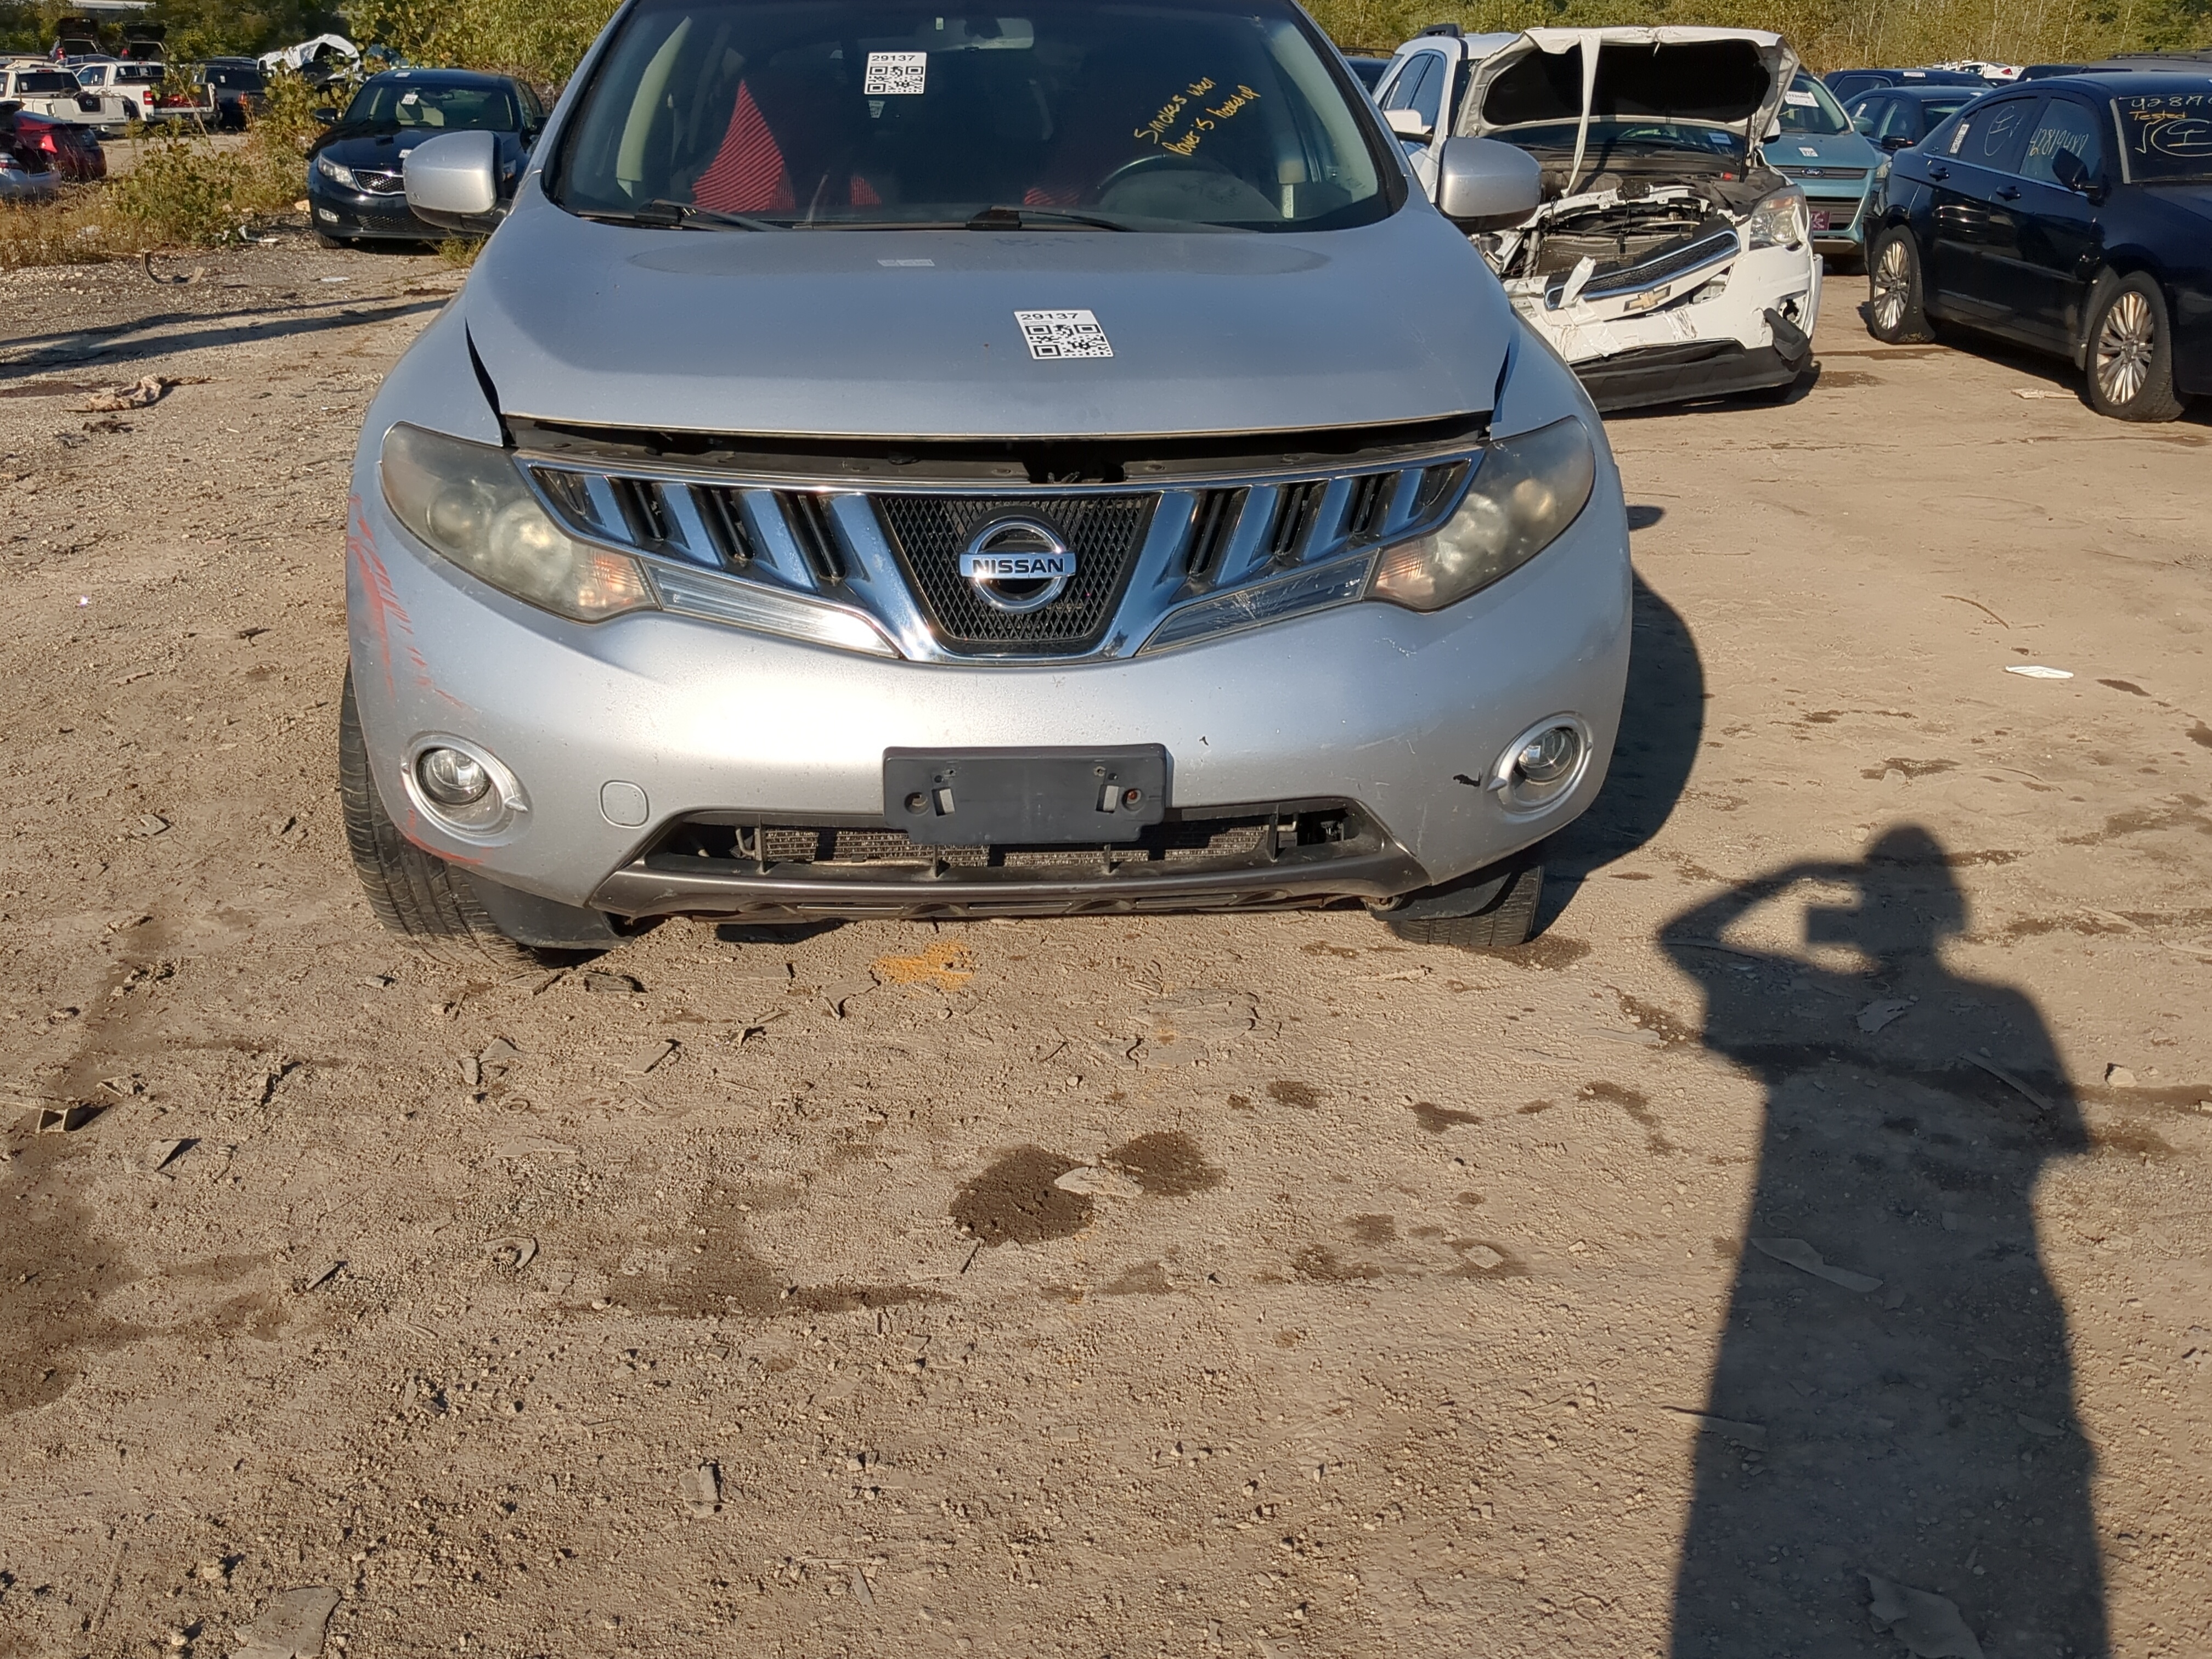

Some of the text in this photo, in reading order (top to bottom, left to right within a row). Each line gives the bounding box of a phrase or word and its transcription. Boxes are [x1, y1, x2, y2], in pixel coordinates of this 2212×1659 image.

[2129, 110, 2186, 121] Tested
[1189, 117, 1215, 131] is
[972, 558, 1064, 574] NISSAN
